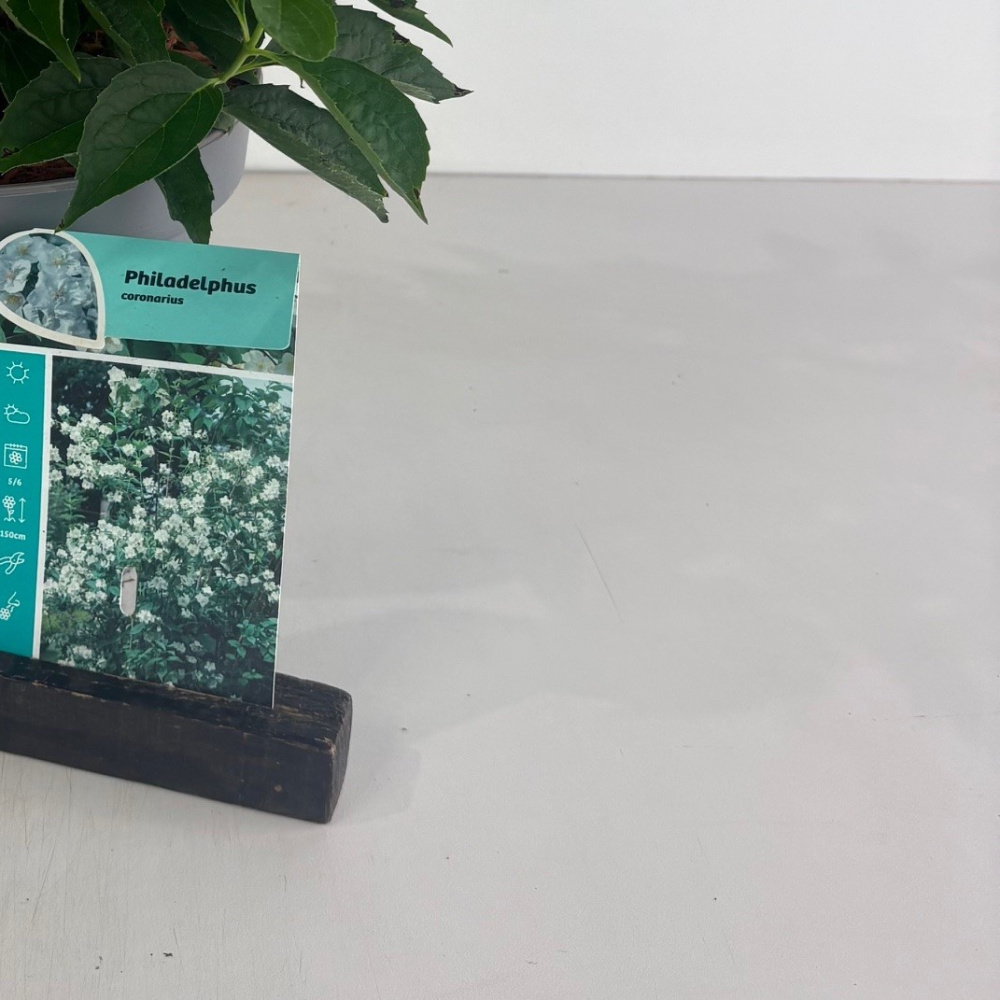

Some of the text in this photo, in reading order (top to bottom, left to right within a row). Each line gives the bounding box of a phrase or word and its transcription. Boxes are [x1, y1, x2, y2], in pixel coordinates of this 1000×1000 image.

[124, 270, 257, 295] Philadelphus
[121, 292, 185, 305] coronarius
[8, 477, 22, 486] 5/6
[0, 530, 26, 541] 150cm
